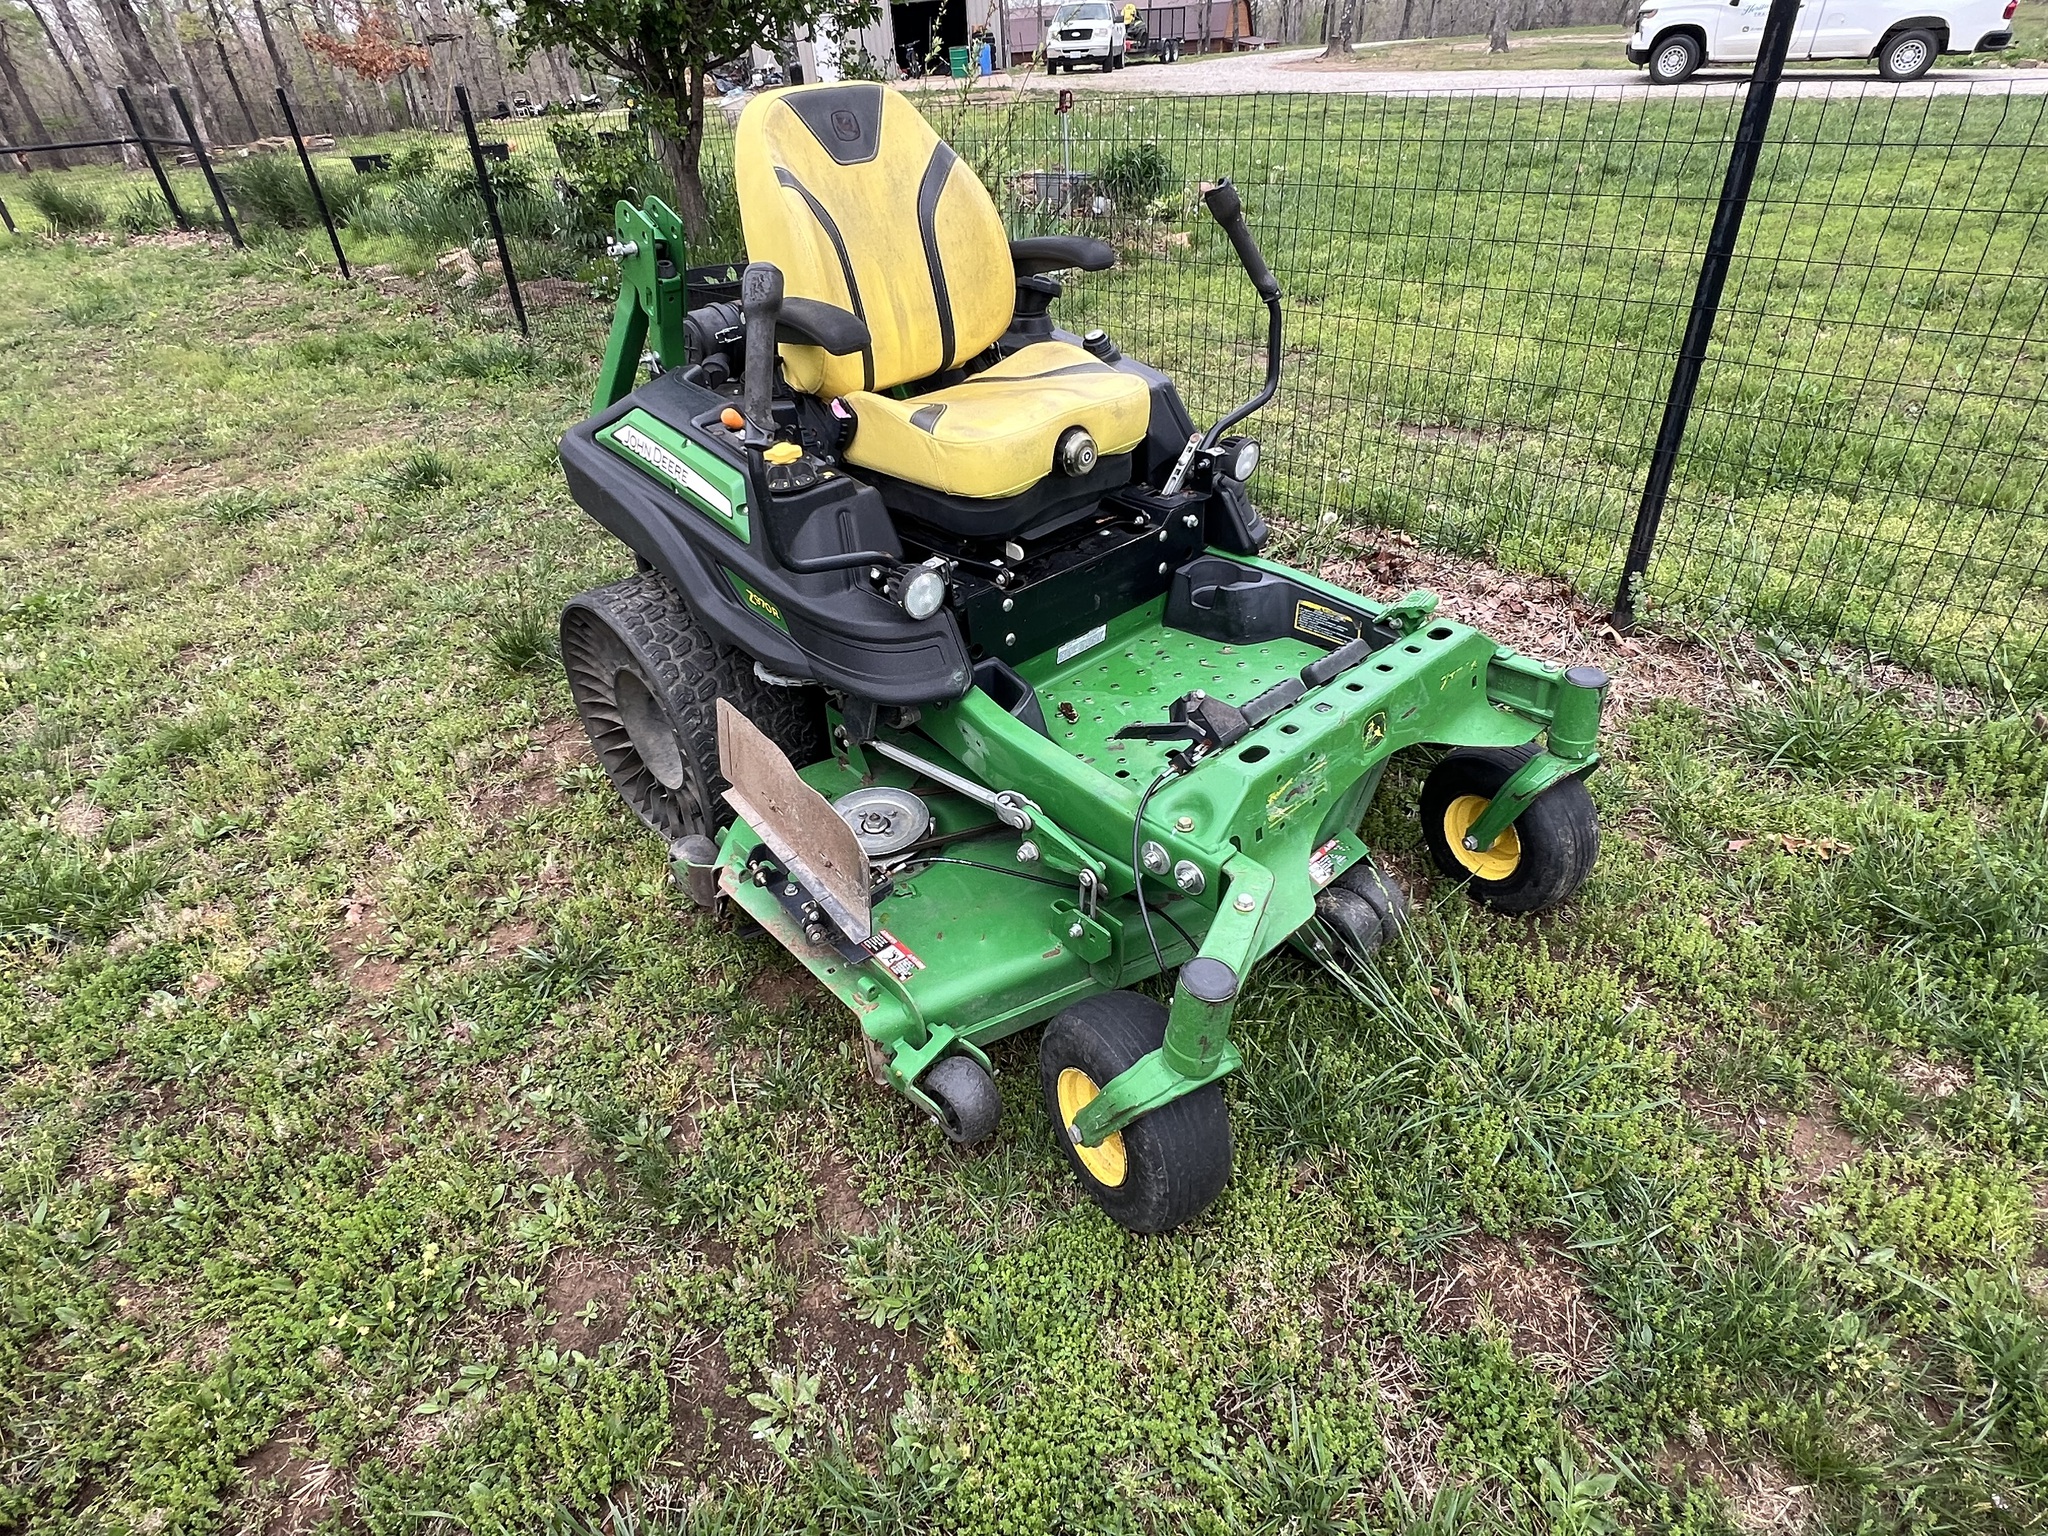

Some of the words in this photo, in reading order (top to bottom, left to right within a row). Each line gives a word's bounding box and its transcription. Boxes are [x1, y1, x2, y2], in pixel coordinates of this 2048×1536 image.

[624, 430, 652, 458] JOHN
[653, 446, 689, 484] DEERE
[745, 588, 781, 620] Z970R
